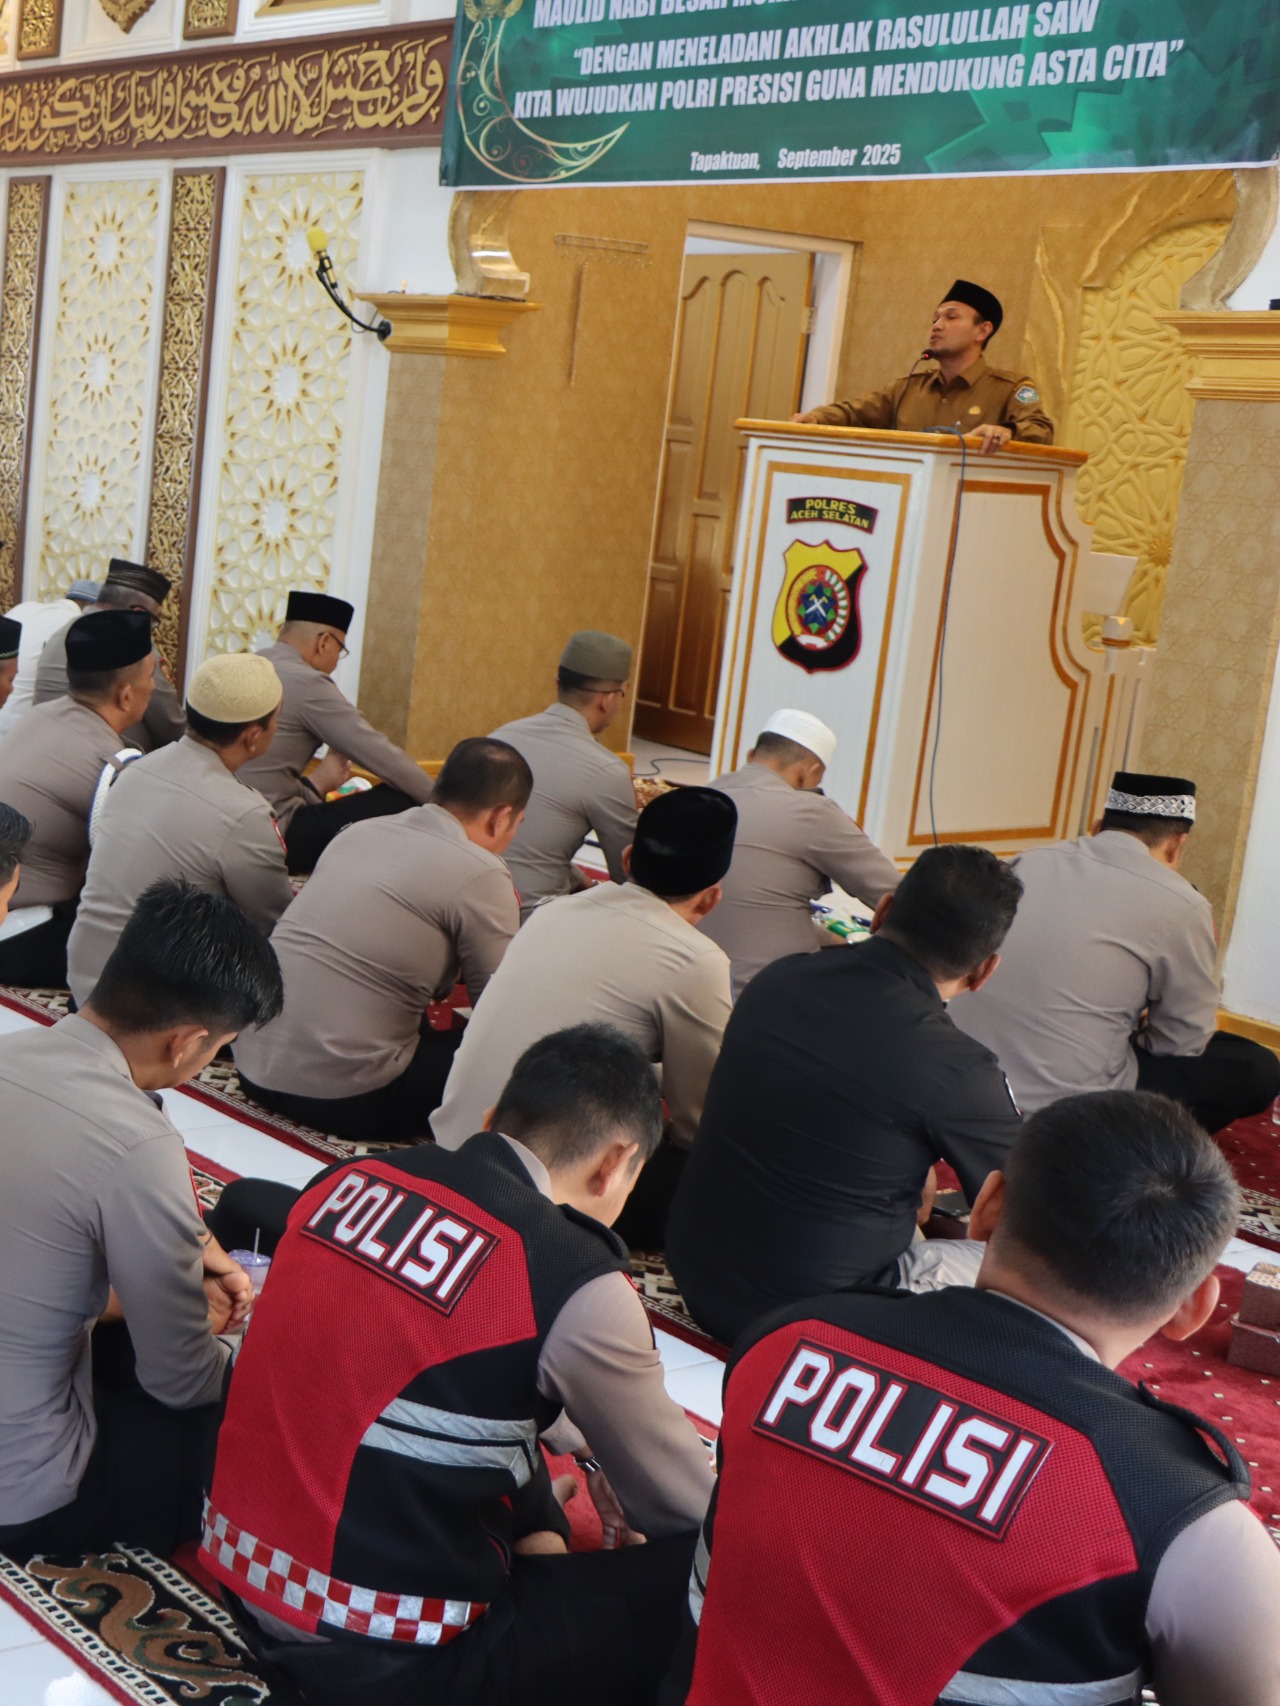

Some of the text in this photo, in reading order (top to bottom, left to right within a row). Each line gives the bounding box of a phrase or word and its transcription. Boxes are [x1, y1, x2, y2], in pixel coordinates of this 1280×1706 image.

[533, 0, 606, 28] MAULID
[656, 29, 782, 70] MENELADANI
[784, 20, 873, 59] AKHLAK
[875, 4, 1029, 52] RASULULLAH
[1033, 0, 1100, 37] SAW
[513, 90, 552, 119] KITA
[555, 82, 657, 118] WUJUDKAN
[660, 78, 717, 110] POLRI
[720, 71, 803, 107] PRESISI
[805, 66, 866, 103] GUNA
[870, 54, 1026, 97] MENDUKUNG
[1027, 48, 1098, 86] ASTA
[690, 143, 901, 172] Tapaktuan, September 2025
[790, 510, 869, 528] ACEH SELATAN
[805, 499, 857, 514] POLRES
[307, 1172, 488, 1301] POLISI
[762, 1346, 1037, 1524] POLISI
